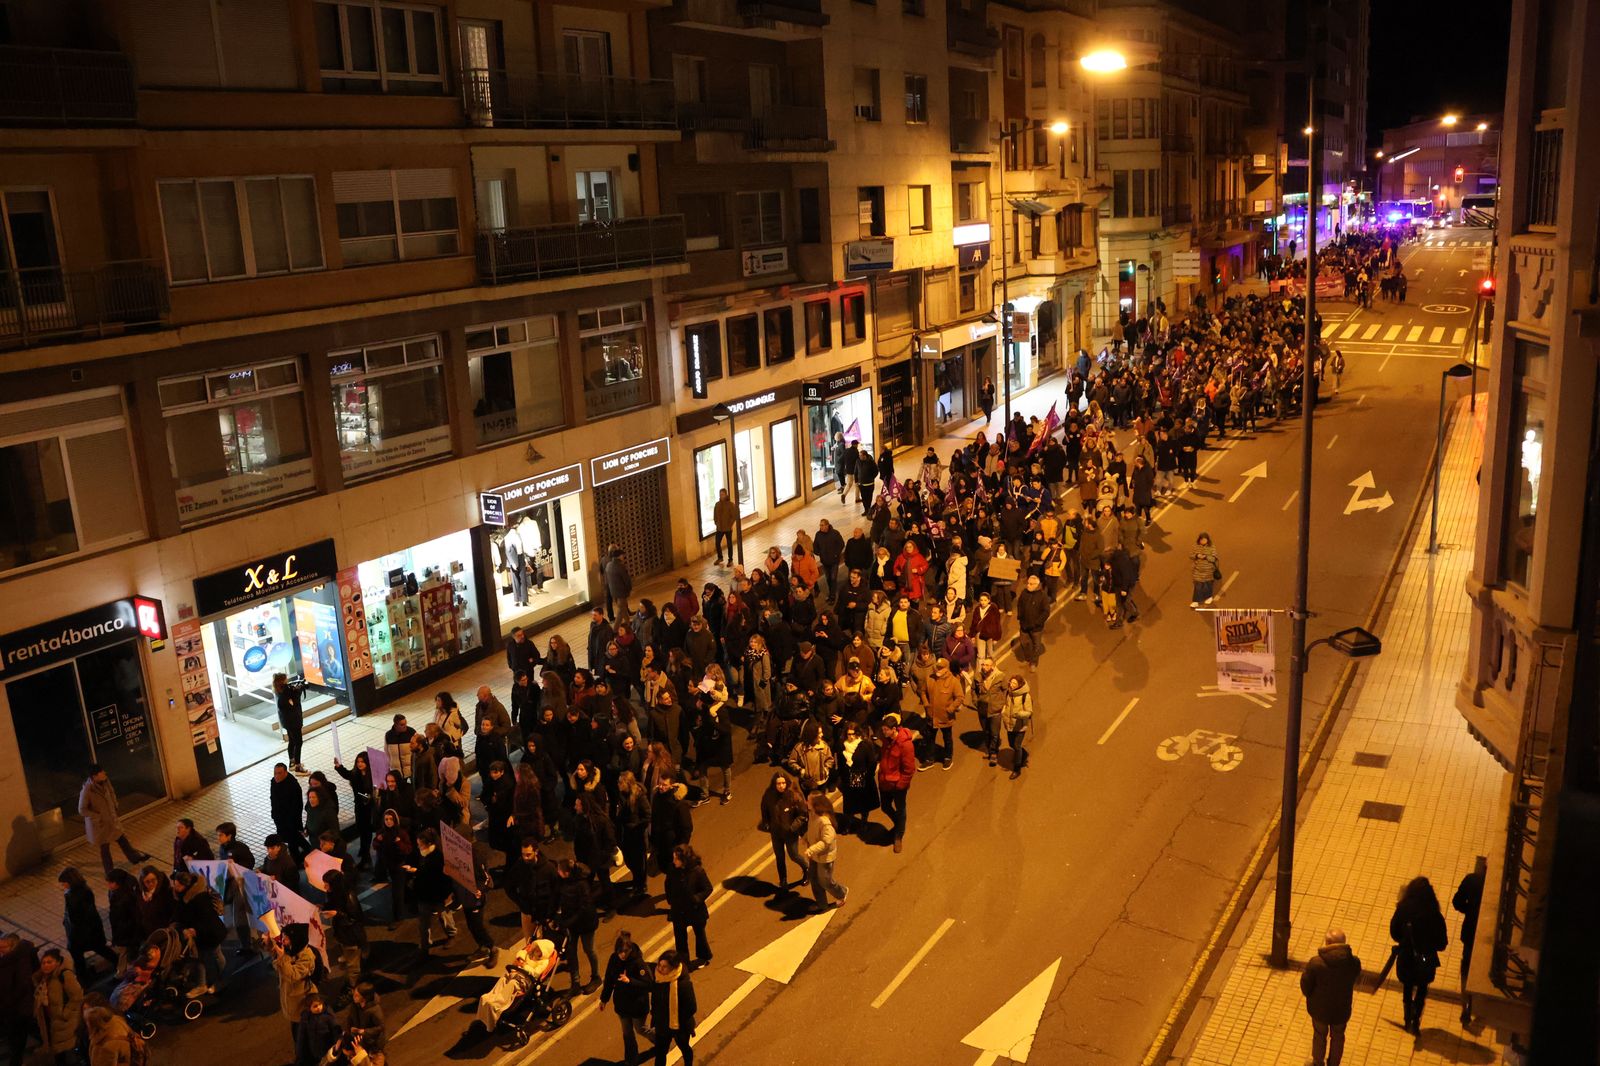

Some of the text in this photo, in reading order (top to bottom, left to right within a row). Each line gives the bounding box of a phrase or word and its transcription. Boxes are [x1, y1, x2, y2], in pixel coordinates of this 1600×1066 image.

[829, 374, 856, 389] FLORENTINO
[727, 392, 776, 413] OLFO DOMINGUEZ
[603, 446, 659, 470] LION OF PORCHES
[503, 473, 570, 501] LION OF PORCHES
[529, 491, 548, 502] LONDON
[179, 502, 194, 515] STE
[571, 537, 579, 559] NEW
[244, 554, 299, 593] X & L
[223, 593, 255, 607] Teléfonos
[255, 584, 279, 598] Móviles
[285, 571, 319, 586] Accesorios
[1225, 620, 1259, 638] STOCK
[7, 617, 125, 665] renta4banco
